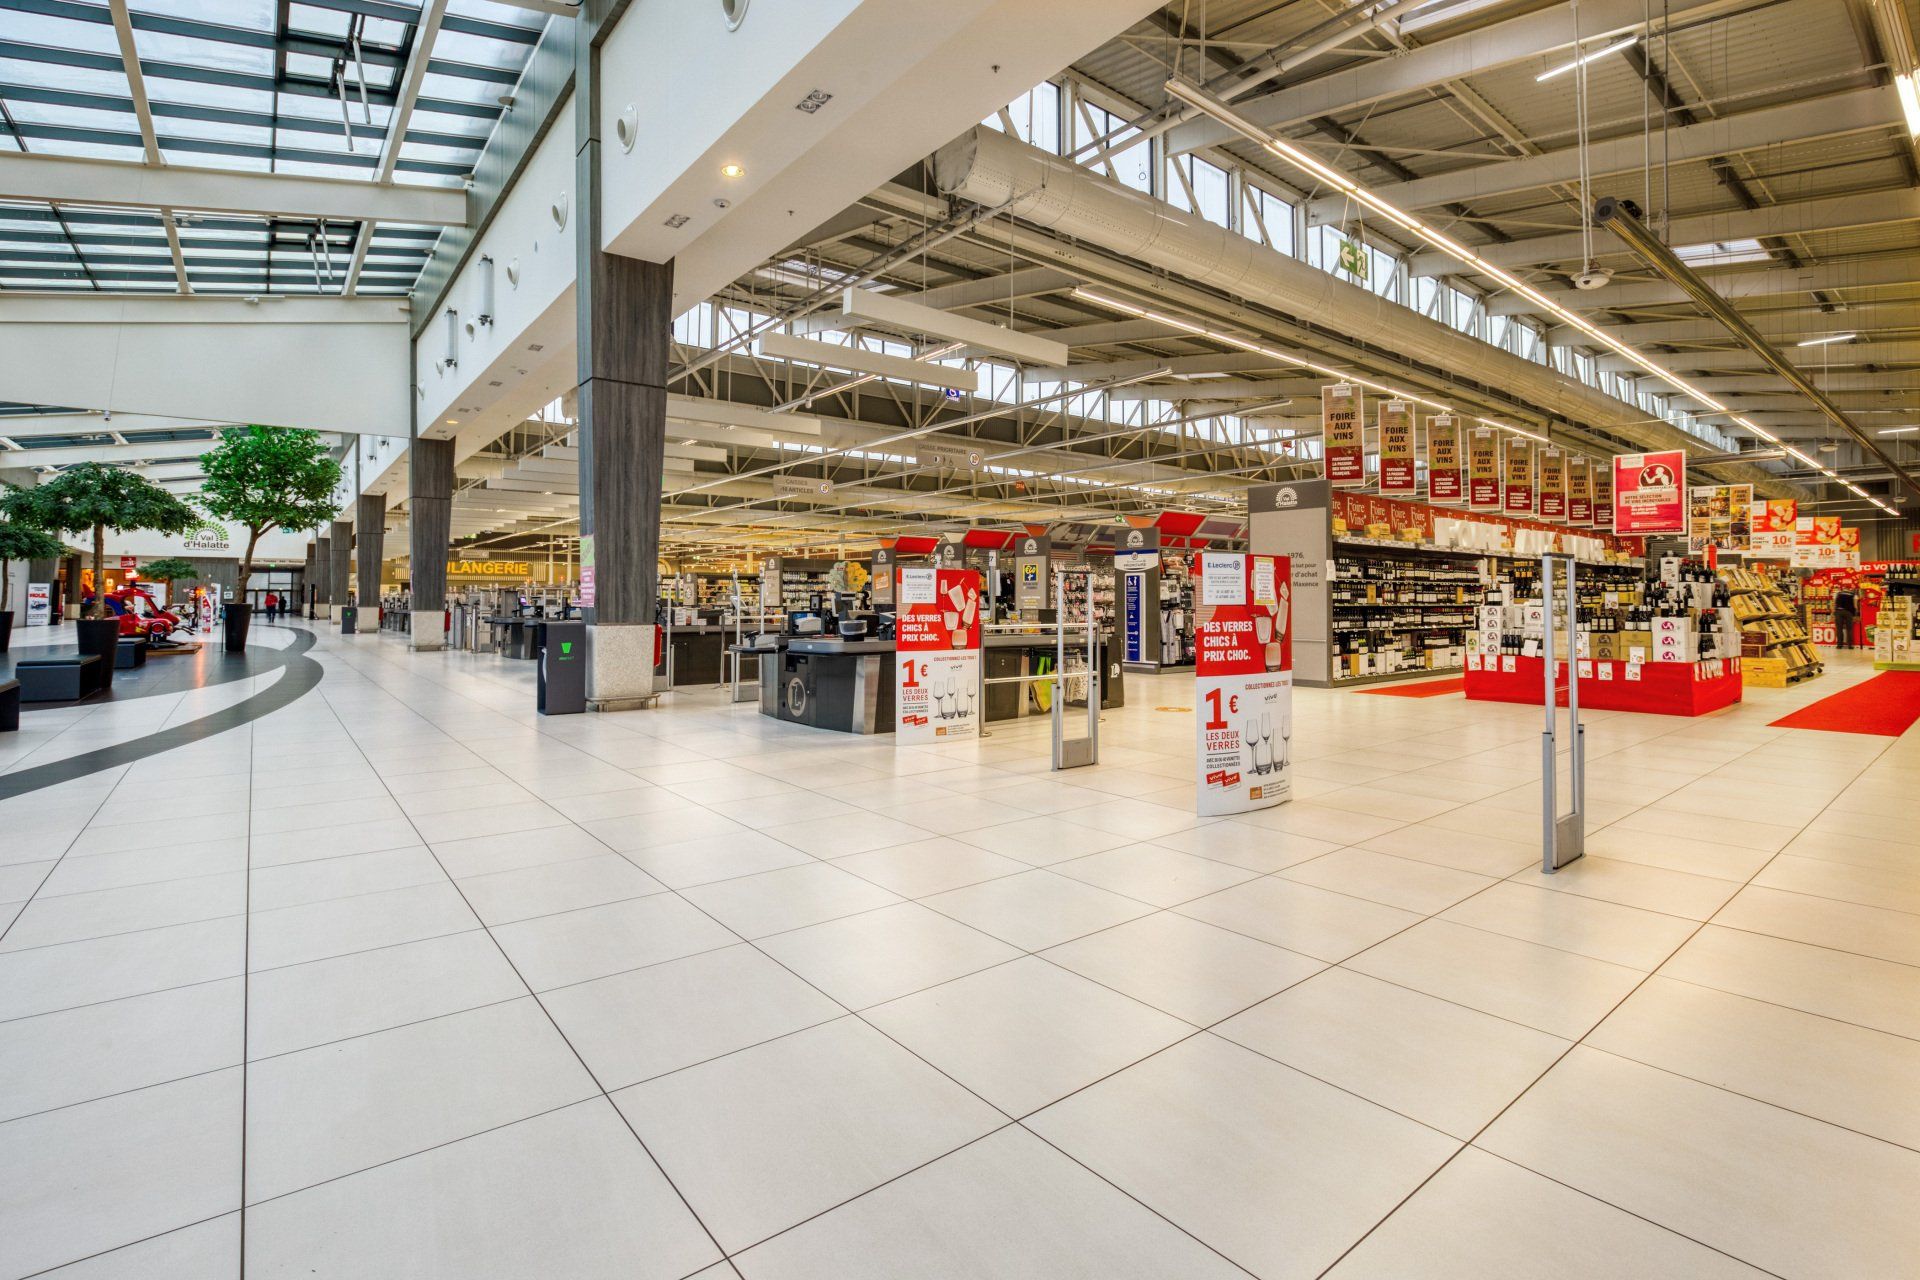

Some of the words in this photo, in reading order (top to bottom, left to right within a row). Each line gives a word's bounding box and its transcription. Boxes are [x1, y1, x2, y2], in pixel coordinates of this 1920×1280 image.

[1330, 412, 1356, 421] FOIRE
[1334, 422, 1352, 430] AUX
[1385, 426, 1408, 434] FOIRE
[1333, 431, 1354, 440] VINS
[1388, 435, 1405, 443] AUX
[1433, 439, 1454, 447] FOIRE
[937, 446, 967, 455] PRIORITAIRE
[1388, 444, 1407, 452] VINS
[1347, 496, 1365, 513] Foire
[1370, 500, 1386, 516] Foire
[1390, 503, 1406, 519] Foire
[183, 540, 230, 549] d'Halatte
[447, 561, 528, 575] LANGERIE
[901, 614, 916, 622] DES
[916, 614, 942, 622] VERRES
[901, 623, 923, 632] CHICS
[923, 622, 929, 632] À
[1203, 621, 1221, 633] DES
[1222, 620, 1253, 632] VERRES
[901, 633, 919, 642] PRIX
[919, 633, 940, 641] CHOC.
[1203, 635, 1230, 648] CHICS
[1231, 633, 1238, 647] À
[1203, 650, 1225, 662] PRIX
[1227, 649, 1251, 661] CHOC.
[902, 694, 929, 702] VERRES
[1206, 732, 1219, 741] LES
[1221, 730, 1240, 740] DEUX
[1206, 739, 1240, 751] VERRES
